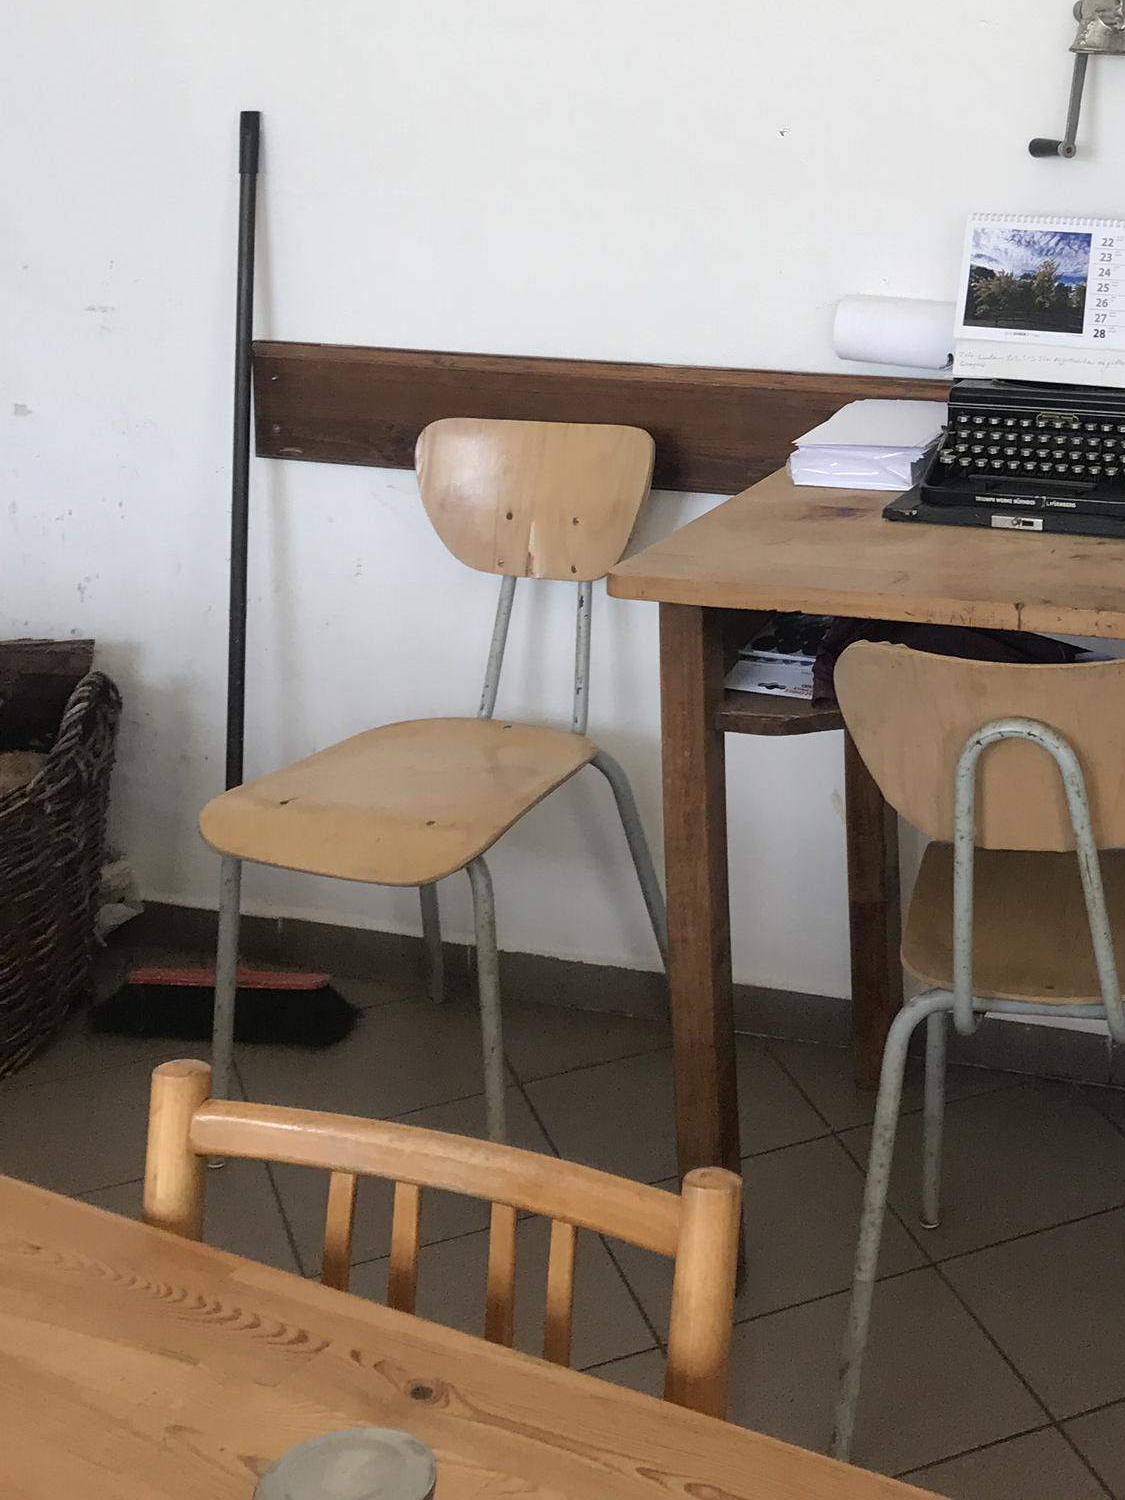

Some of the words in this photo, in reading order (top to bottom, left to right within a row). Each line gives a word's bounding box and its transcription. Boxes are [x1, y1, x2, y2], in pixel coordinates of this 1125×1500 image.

[1101, 237, 1115, 248] 22
[1099, 252, 1113, 263] 23
[1098, 267, 1111, 278] 24
[1096, 282, 1110, 293] 25
[1095, 298, 1109, 308] 26
[1094, 313, 1107, 323] 27
[1092, 328, 1106, 339] 28
